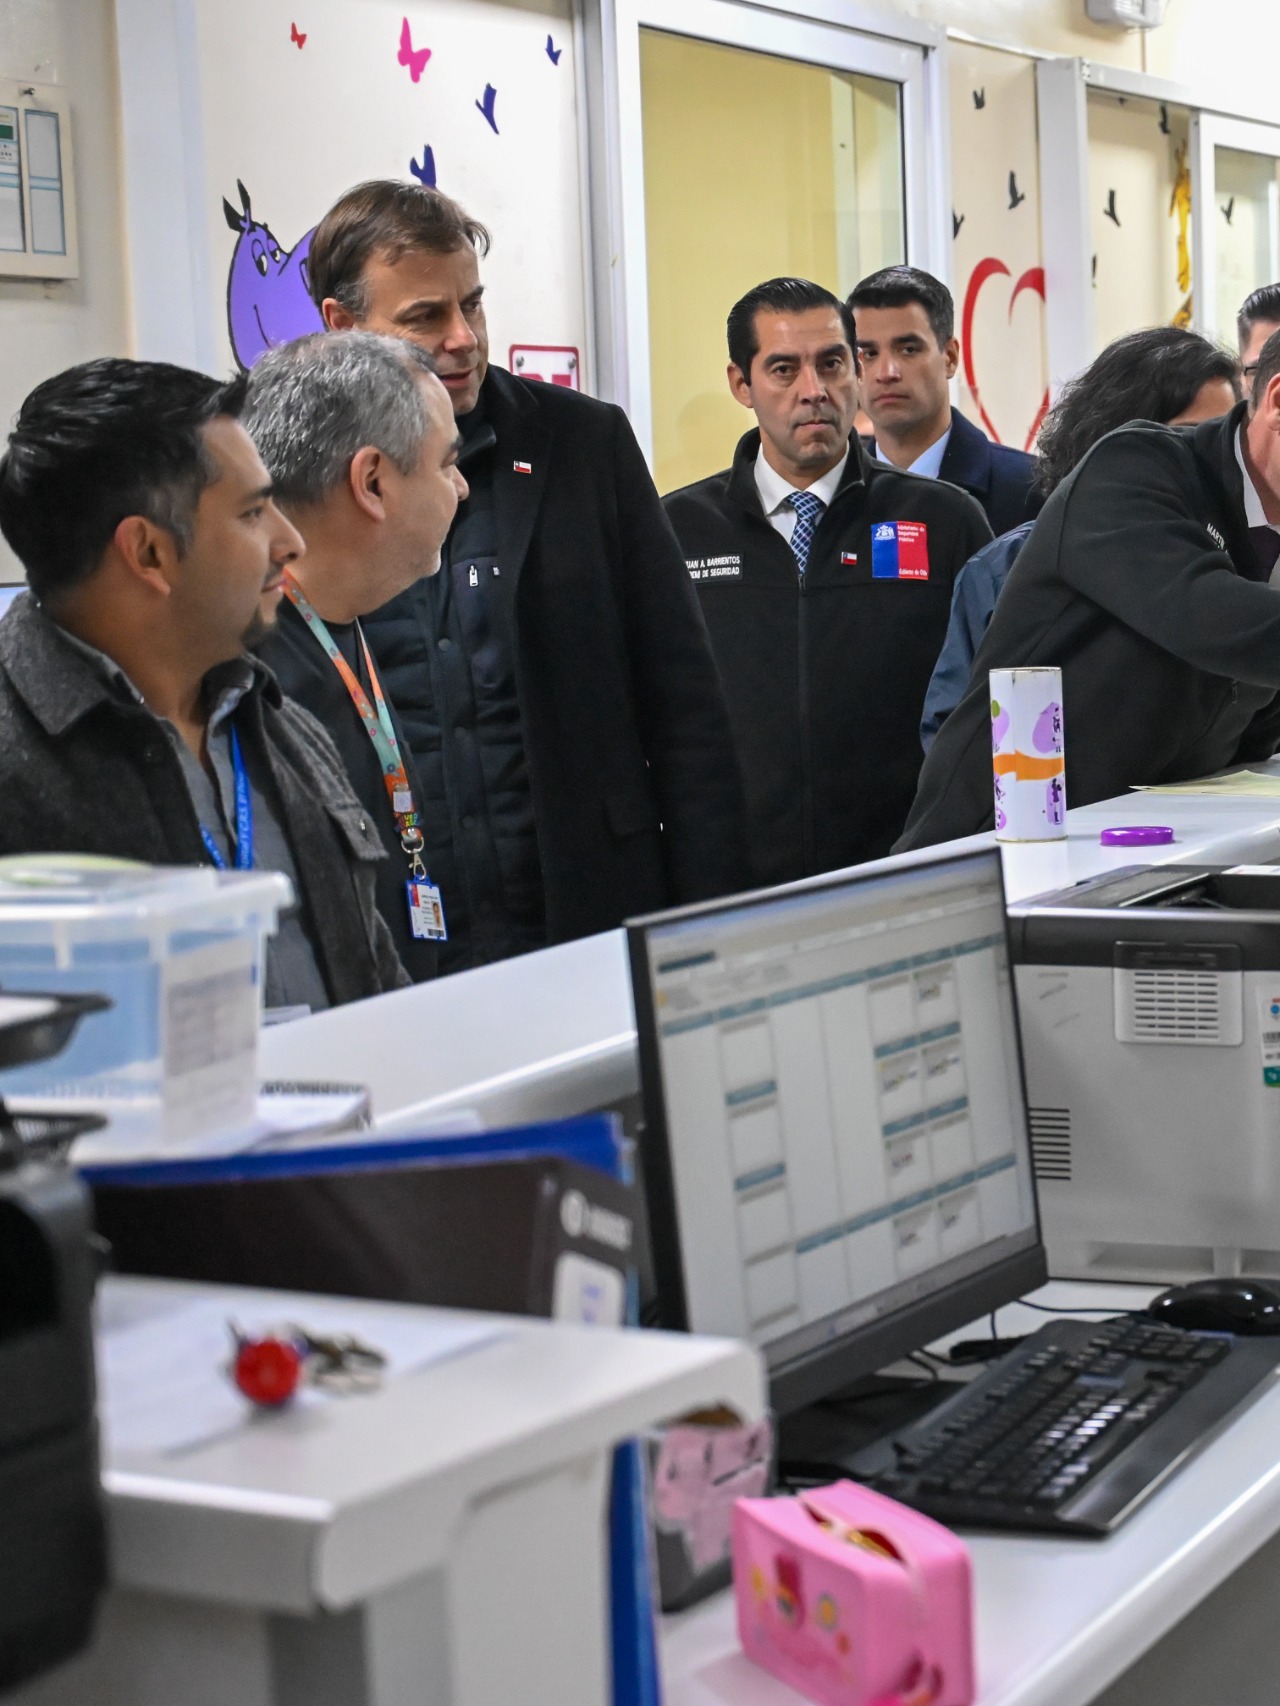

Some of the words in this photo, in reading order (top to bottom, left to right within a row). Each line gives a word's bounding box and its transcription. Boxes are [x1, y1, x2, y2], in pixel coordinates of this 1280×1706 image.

[706, 556, 741, 567] BARRIENTOS
[702, 569, 709, 578] DE
[710, 566, 740, 577] SEGURIDAD
